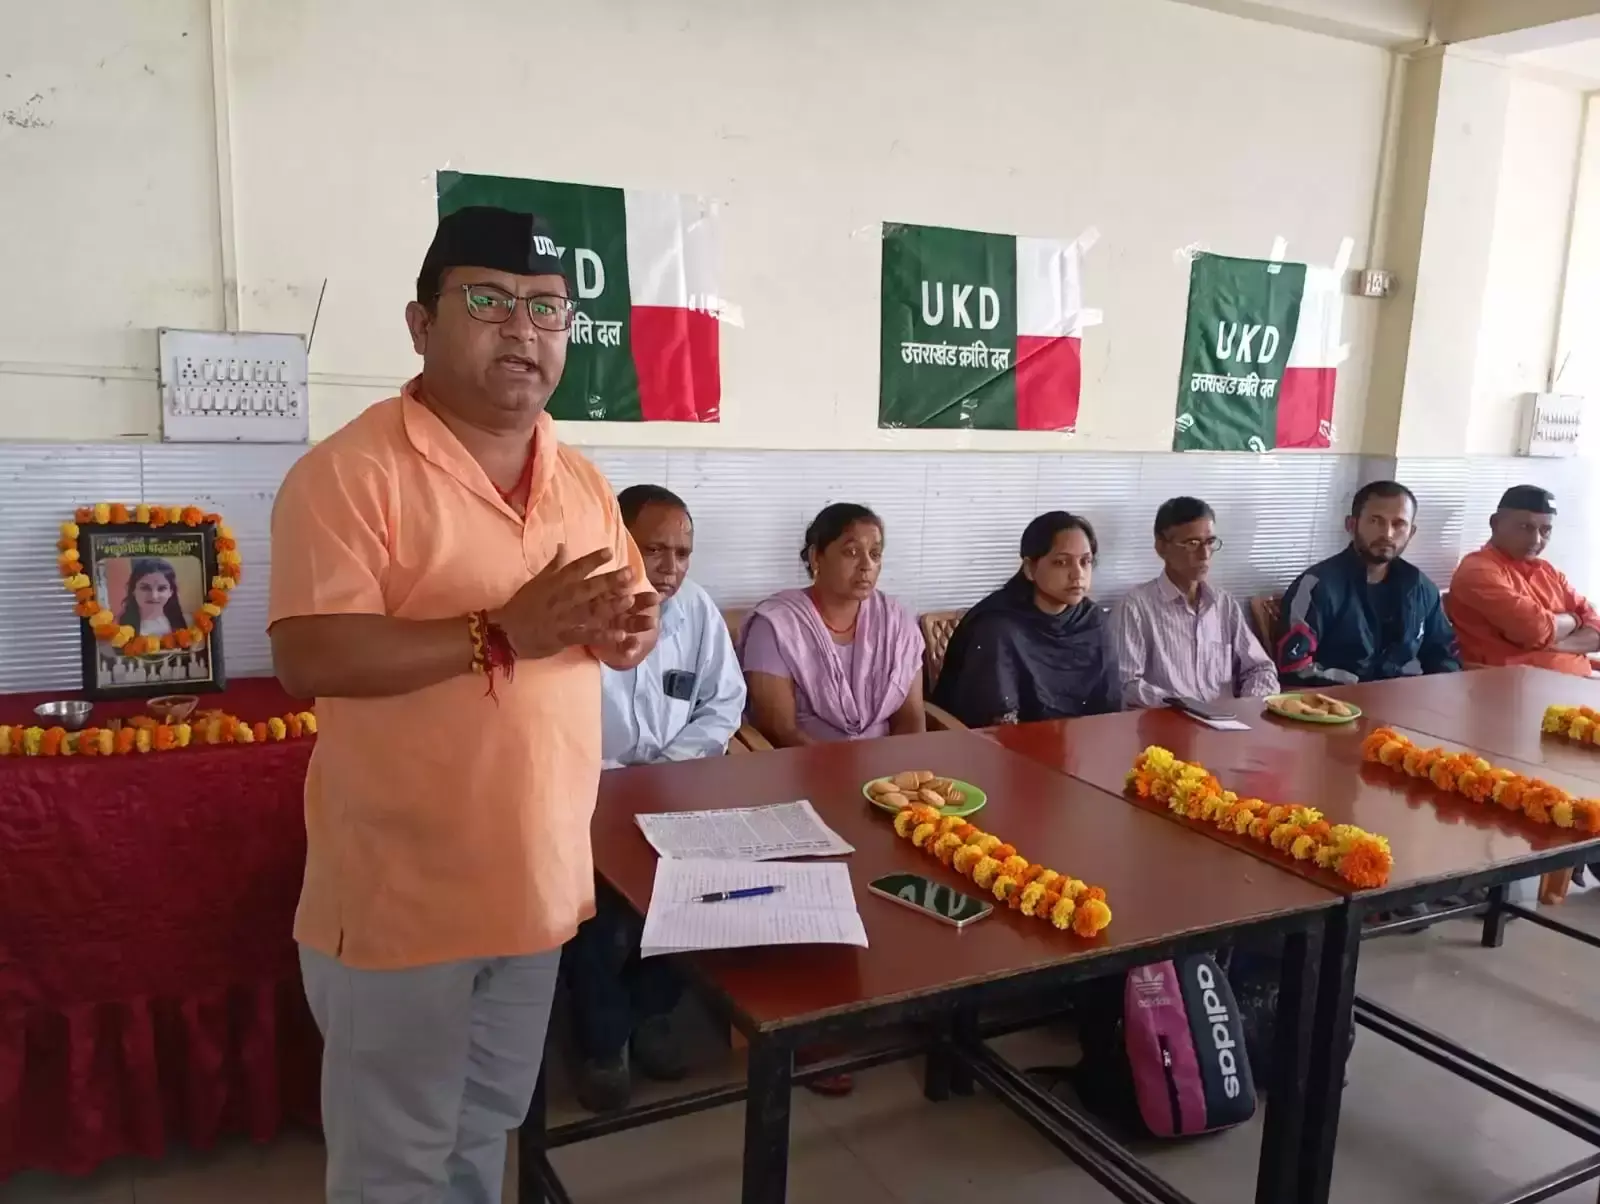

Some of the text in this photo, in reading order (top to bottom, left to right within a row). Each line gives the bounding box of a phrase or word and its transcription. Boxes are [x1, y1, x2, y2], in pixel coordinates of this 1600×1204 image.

[921, 280, 1000, 330] UKD
[595, 320, 623, 348] दल
[900, 340, 1012, 371] उत्तराखंड क्रांति दल
[1216, 320, 1280, 364] UKD
[1197, 963, 1240, 1099] adidas
